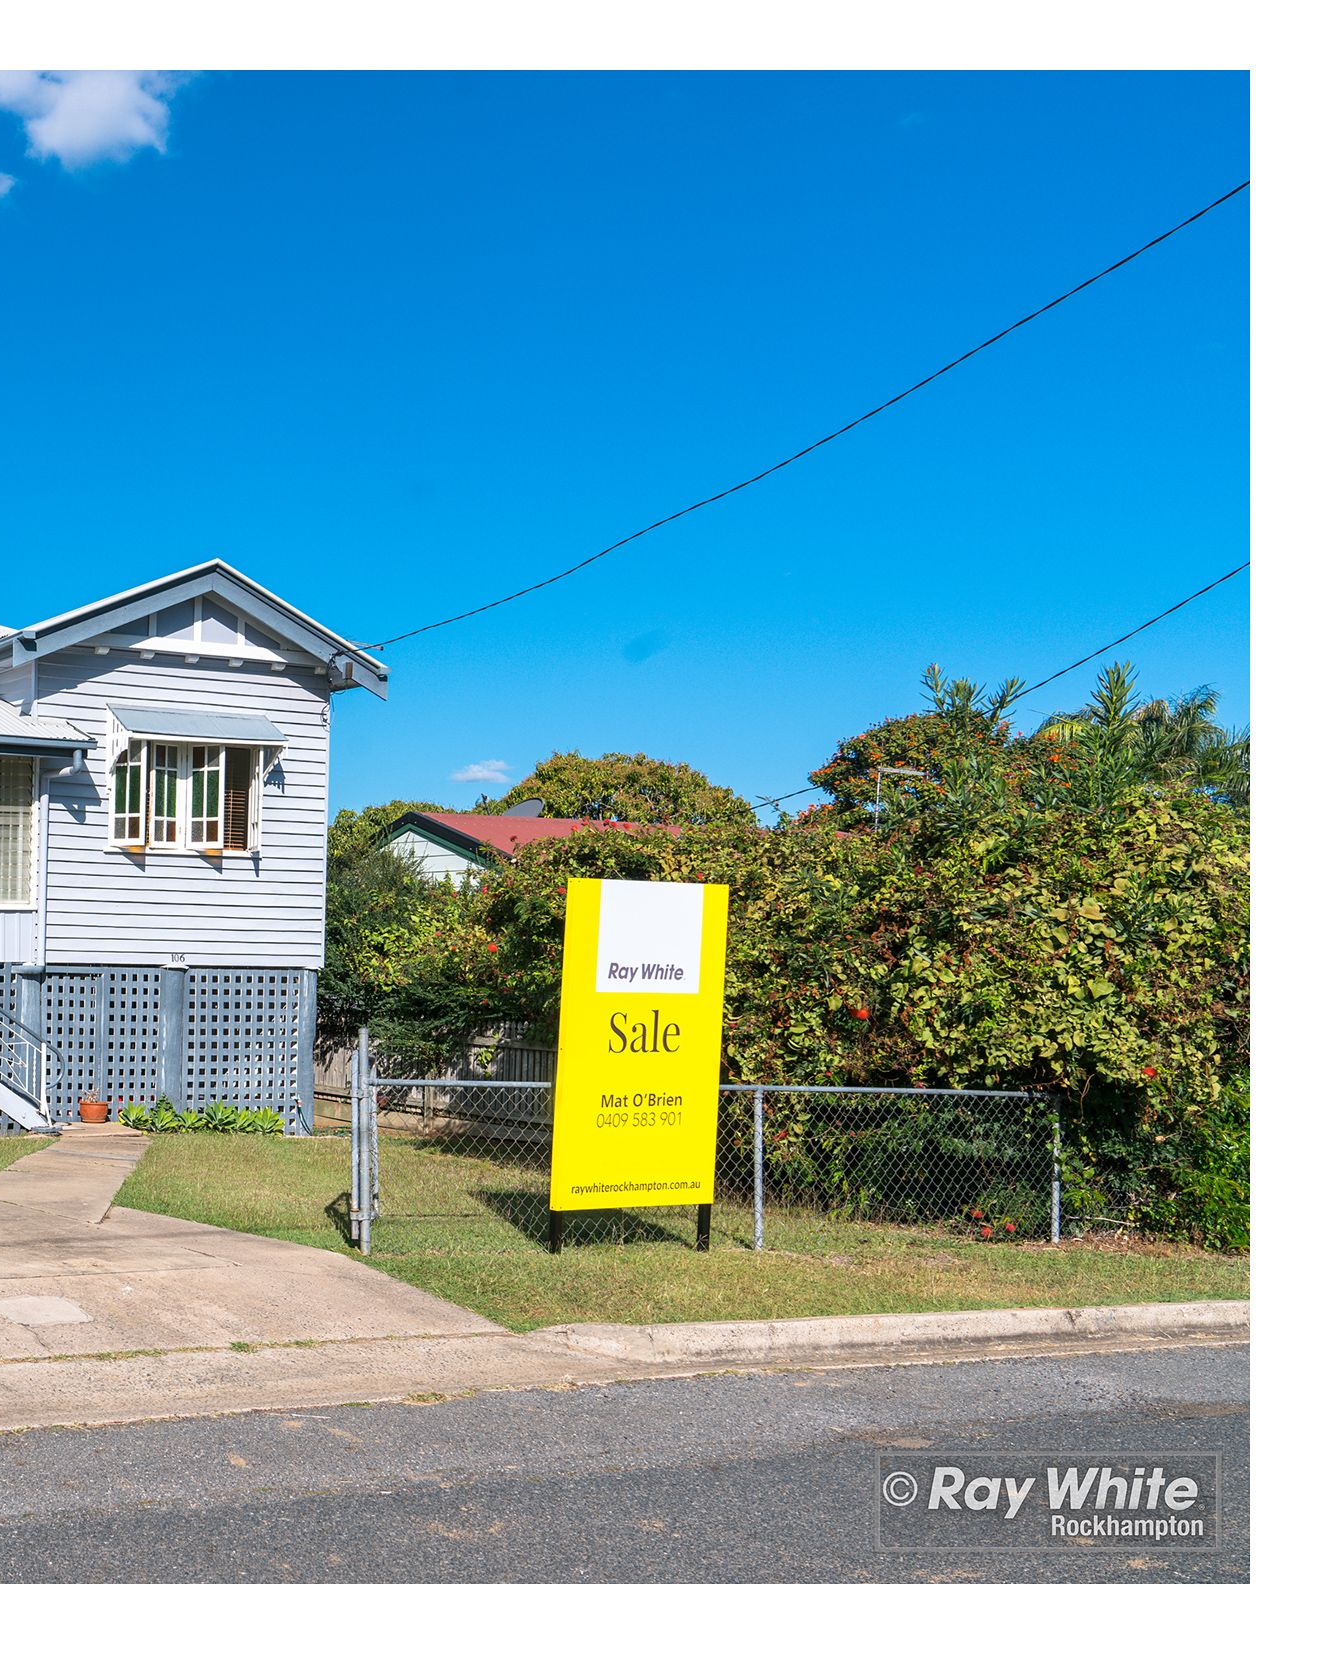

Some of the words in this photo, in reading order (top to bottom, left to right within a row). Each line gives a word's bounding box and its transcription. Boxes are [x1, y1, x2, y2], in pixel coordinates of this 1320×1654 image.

[170, 953, 186, 963] 106
[607, 962, 639, 983] Ray
[641, 963, 684, 981] White
[608, 1009, 681, 1054] Sale
[601, 1094, 629, 1108] Mat
[633, 1092, 683, 1107] O'Brien
[596, 1113, 629, 1128] 0409
[632, 1112, 656, 1127] 583
[660, 1111, 682, 1126] 901
[571, 1181, 701, 1196] raywhiterockhampton.com.au
